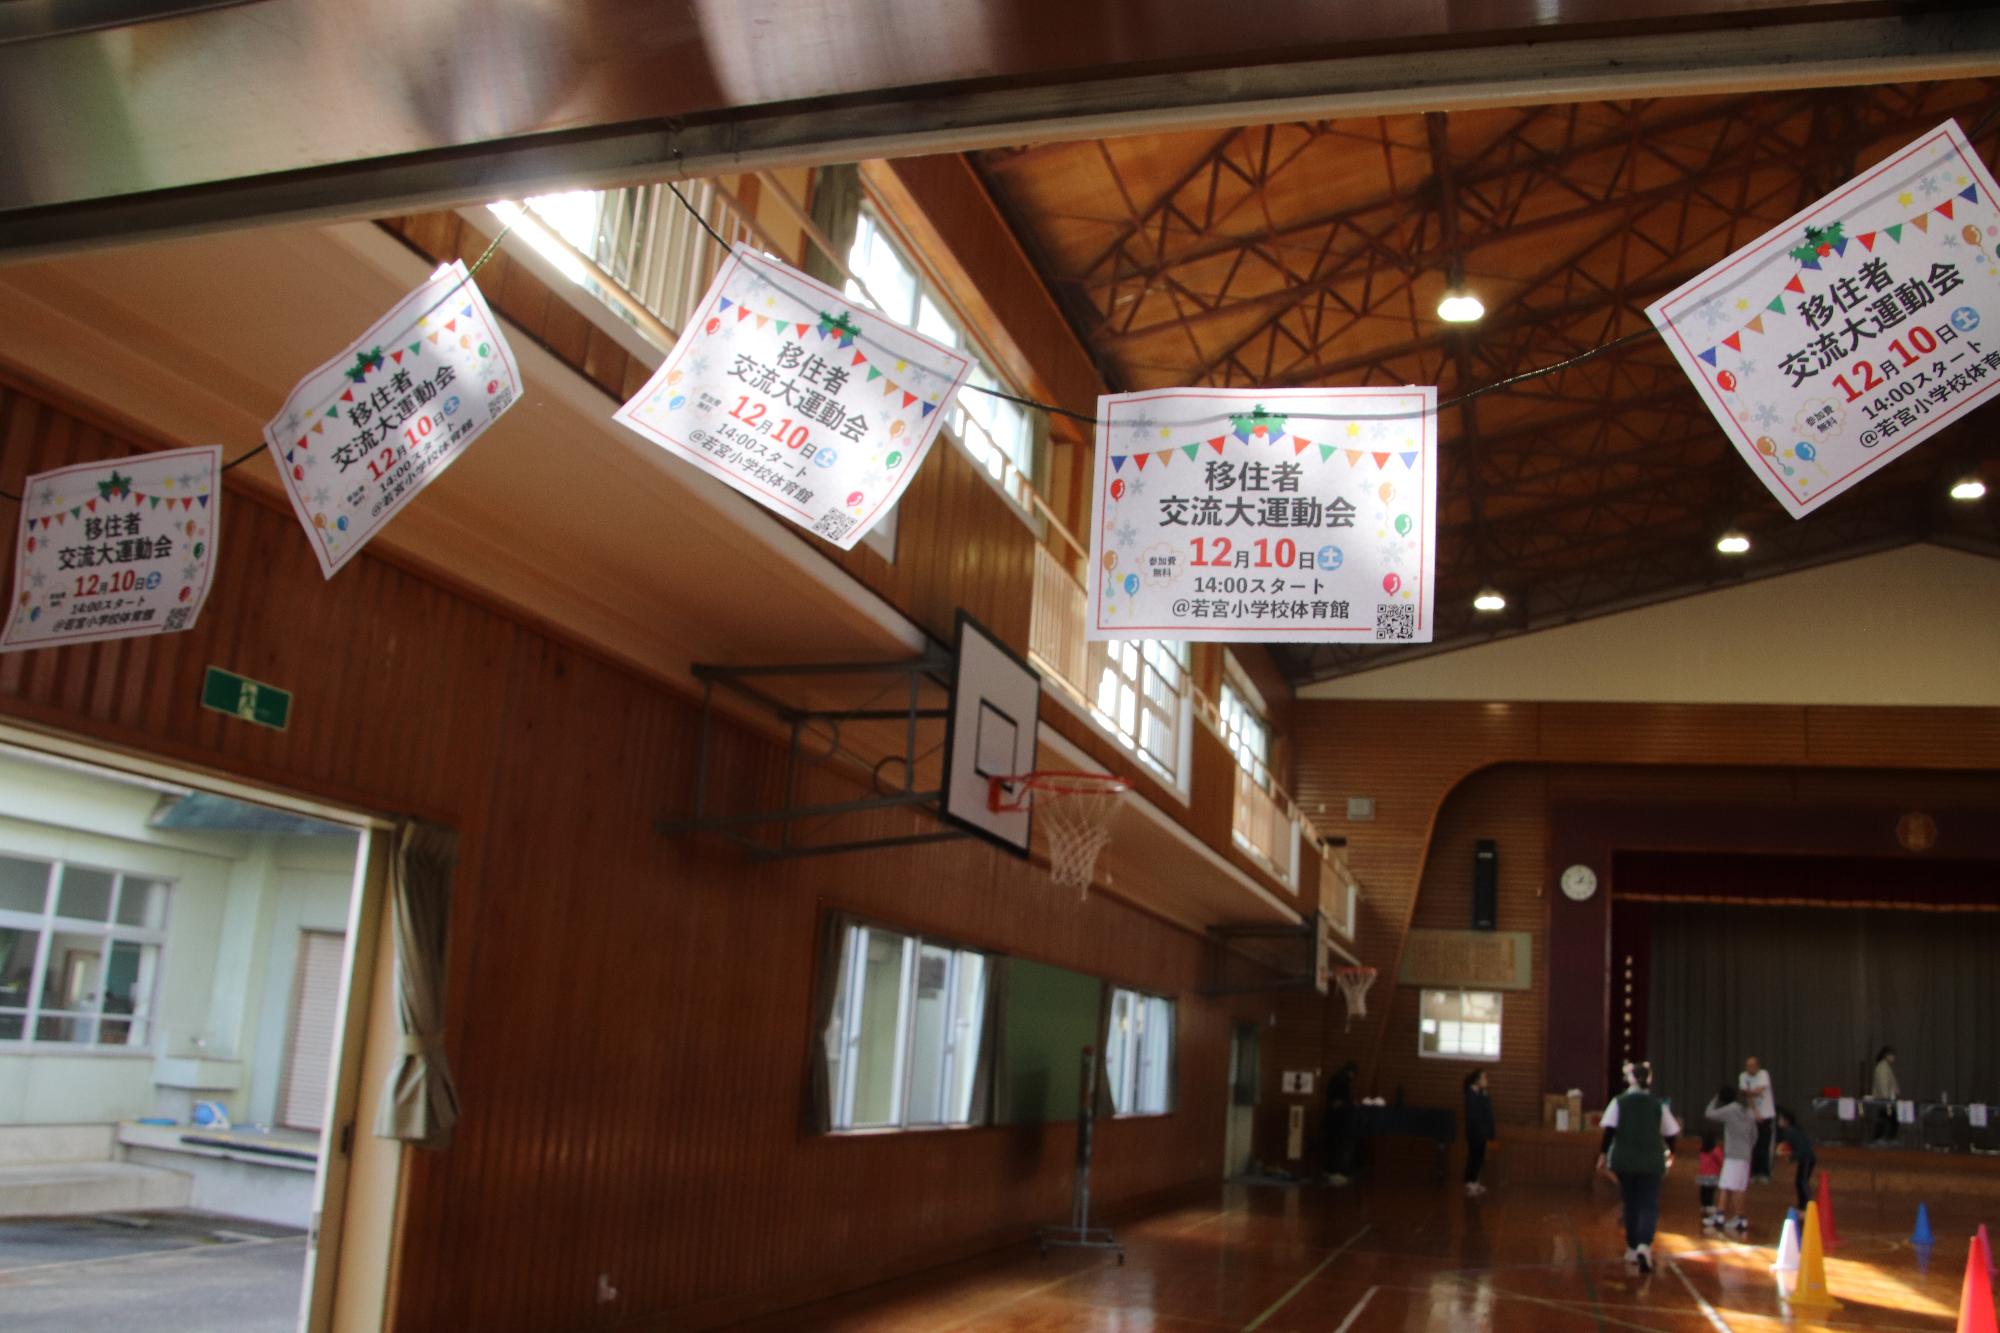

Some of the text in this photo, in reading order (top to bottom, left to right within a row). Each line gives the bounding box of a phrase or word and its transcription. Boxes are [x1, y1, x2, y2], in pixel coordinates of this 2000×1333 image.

[1797, 257, 1894, 331] 移住者
[1778, 262, 1964, 388] 交流大運動会
[777, 340, 850, 396] 移住者
[1861, 340, 1982, 420] 14:00スタート
[331, 365, 456, 474] 交流大運動会
[347, 368, 413, 428] 移住者
[727, 352, 869, 443] 交流大運動会
[379, 423, 454, 493] 14:00スタート
[688, 429, 814, 505] @若宮小学校体育館
[715, 422, 808, 479] 14:00スタート
[1204, 460, 1303, 493] 移住者
[84, 512, 142, 541] 移住者
[1159, 495, 1357, 528] 交流大運動会
[58, 534, 172, 571] 交流大運動会
[1172, 598, 1350, 620] @若宮小学校体育館
[1193, 576, 1325, 595] 14:00スタート
